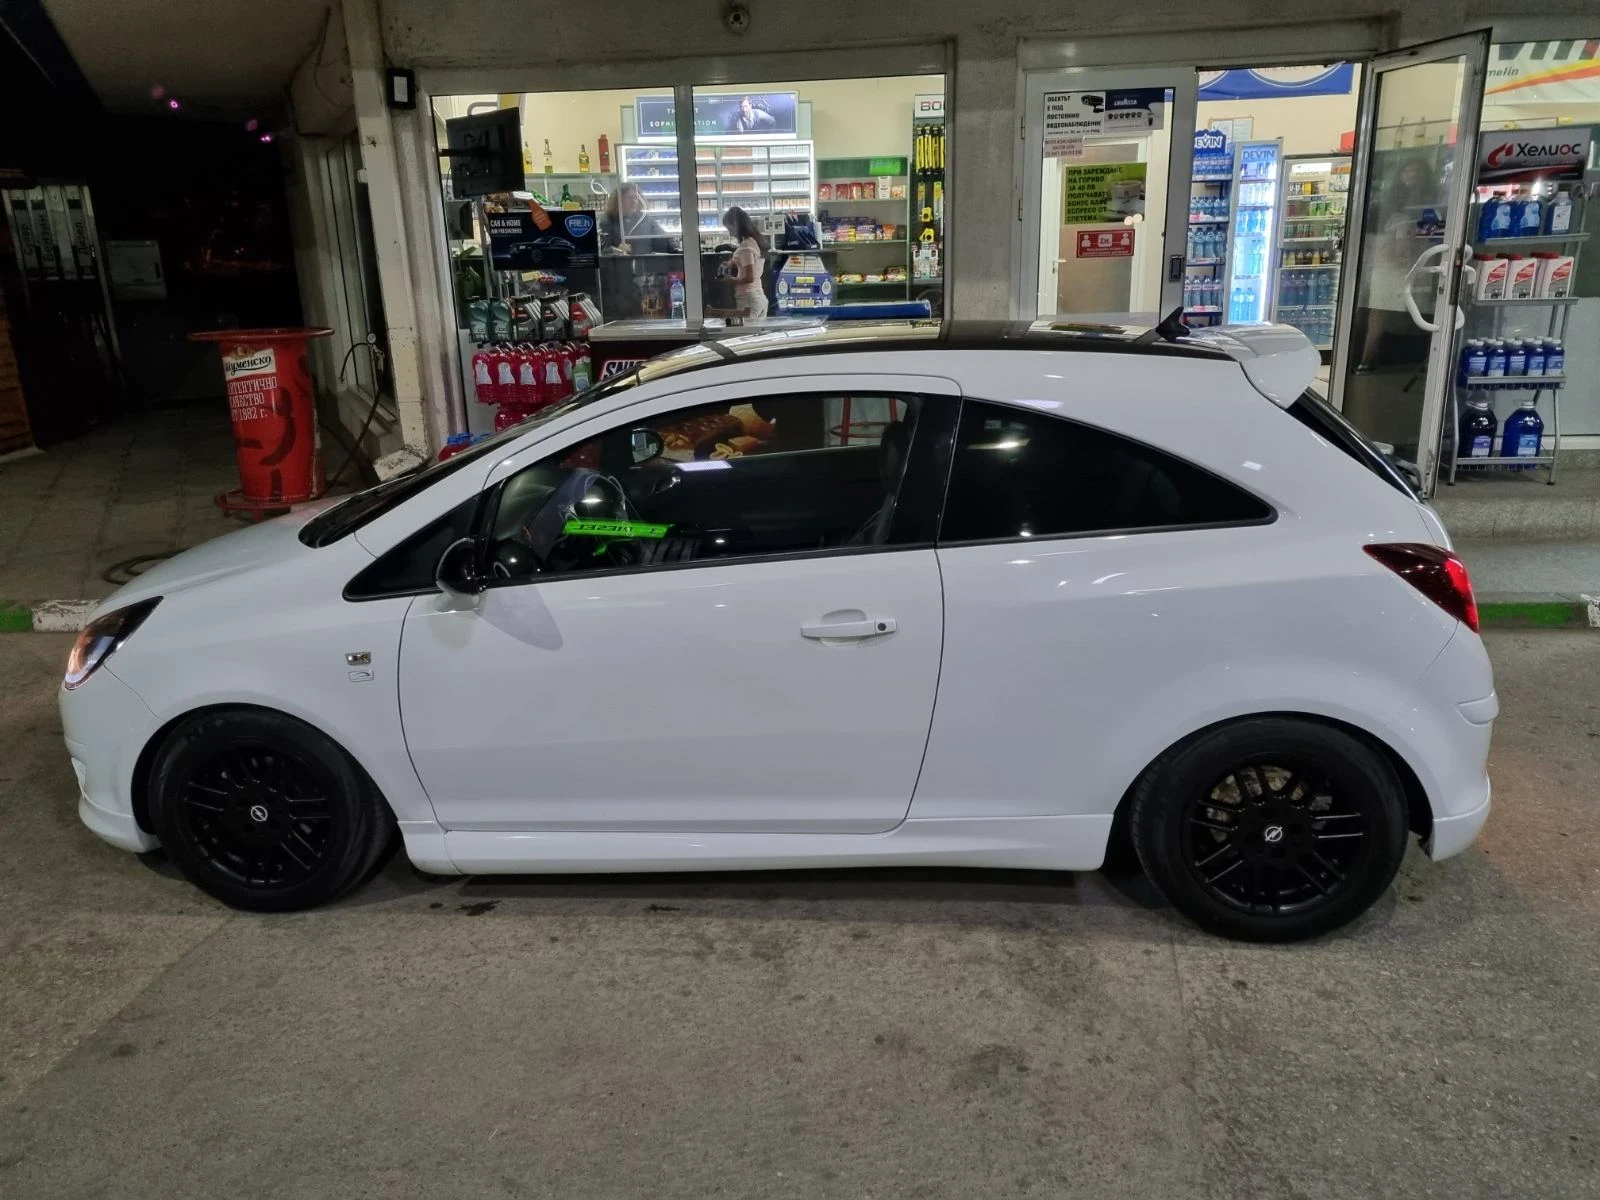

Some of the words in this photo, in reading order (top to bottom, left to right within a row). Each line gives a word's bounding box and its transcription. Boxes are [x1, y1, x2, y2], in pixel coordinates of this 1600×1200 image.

[1047, 95, 1072, 103] ОБЕКТЪТ
[920, 100, 945, 112] BO
[1047, 120, 1102, 129] ВИДЕОНАБЛЮДЕНИЕ
[1243, 149, 1276, 160] DEVIN
[1516, 143, 1582, 157] Хелиос
[1083, 167, 1123, 175] ЗАРЕЖДАНЕ
[490, 219, 501, 228] CAR
[506, 219, 521, 227] HOME
[39, 214, 55, 262] Бензин
[240, 406, 258, 421] 1882
